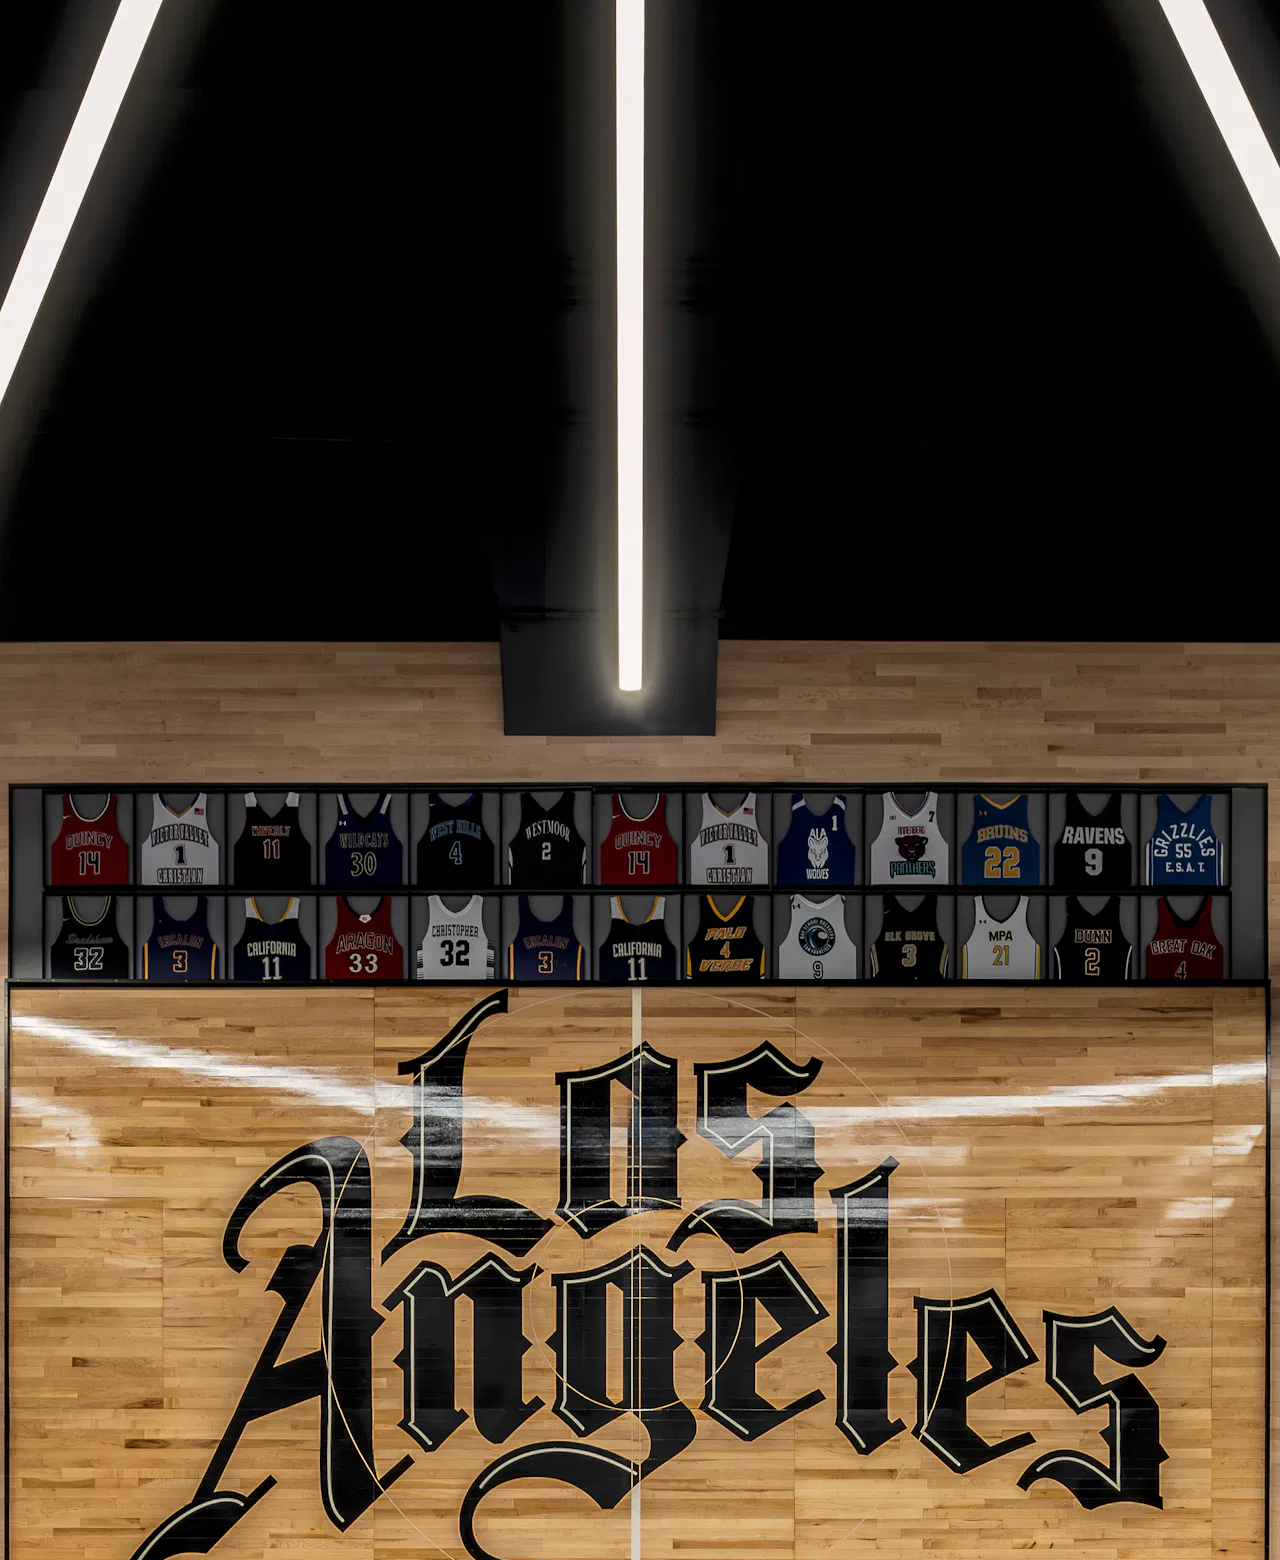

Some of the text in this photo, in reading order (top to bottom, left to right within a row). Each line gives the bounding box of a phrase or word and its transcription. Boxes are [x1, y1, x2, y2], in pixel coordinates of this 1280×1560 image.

[340, 832, 389, 849] WILDCATS
[526, 820, 570, 842] WESTMOOR
[977, 825, 1028, 843] BRUINS
[1062, 826, 1125, 845] RAVENS
[1153, 823, 1215, 858] GRIZZLIES
[1175, 843, 1192, 859] 55
[79, 851, 100, 875] 14
[350, 852, 377, 876] 30
[628, 851, 649, 874] 14
[984, 846, 1020, 878] 22
[1085, 848, 1103, 876] 9
[806, 868, 829, 880] WOLVES
[432, 925, 479, 938] CHRISTOPHER
[989, 931, 1012, 941] MPA
[1075, 930, 1112, 943] DUNN
[247, 941, 296, 958] CALIFORNIA
[336, 932, 393, 954] ARAGON
[440, 939, 470, 967] 32
[74, 948, 104, 971] 32
[349, 954, 378, 973] 33
[992, 945, 1010, 966] 21
[381, 988, 824, 1265] Los
